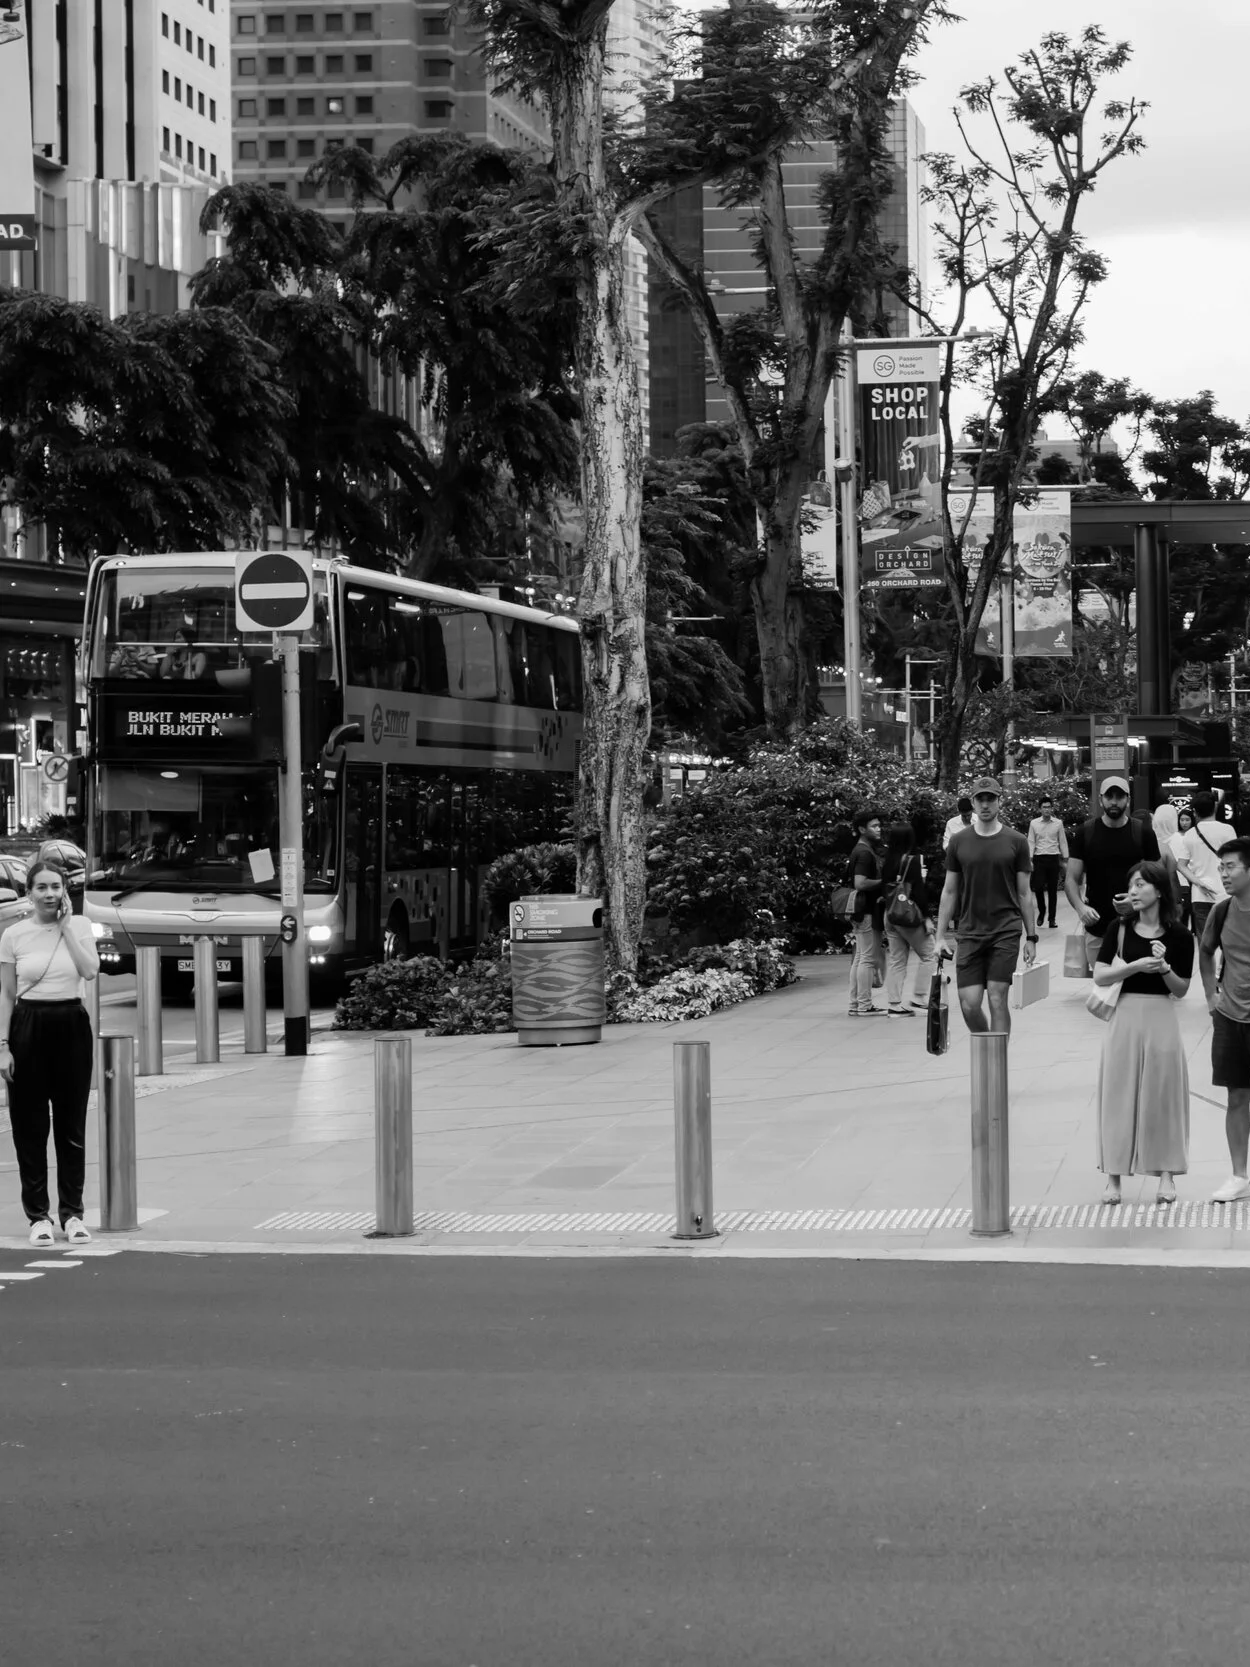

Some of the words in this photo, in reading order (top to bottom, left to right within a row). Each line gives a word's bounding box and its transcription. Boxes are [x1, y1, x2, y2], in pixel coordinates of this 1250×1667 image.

[876, 361, 893, 371] SG
[871, 386, 929, 404] SHOP
[871, 405, 929, 420] LOCAL
[878, 551, 928, 560] DESIGN
[878, 560, 929, 568] ORCHARD
[881, 579, 918, 587] ORCHARD
[920, 578, 942, 586] ROAD
[128, 711, 173, 723] BUKIT
[126, 724, 154, 736] JLN
[159, 724, 205, 736] BUKIT
